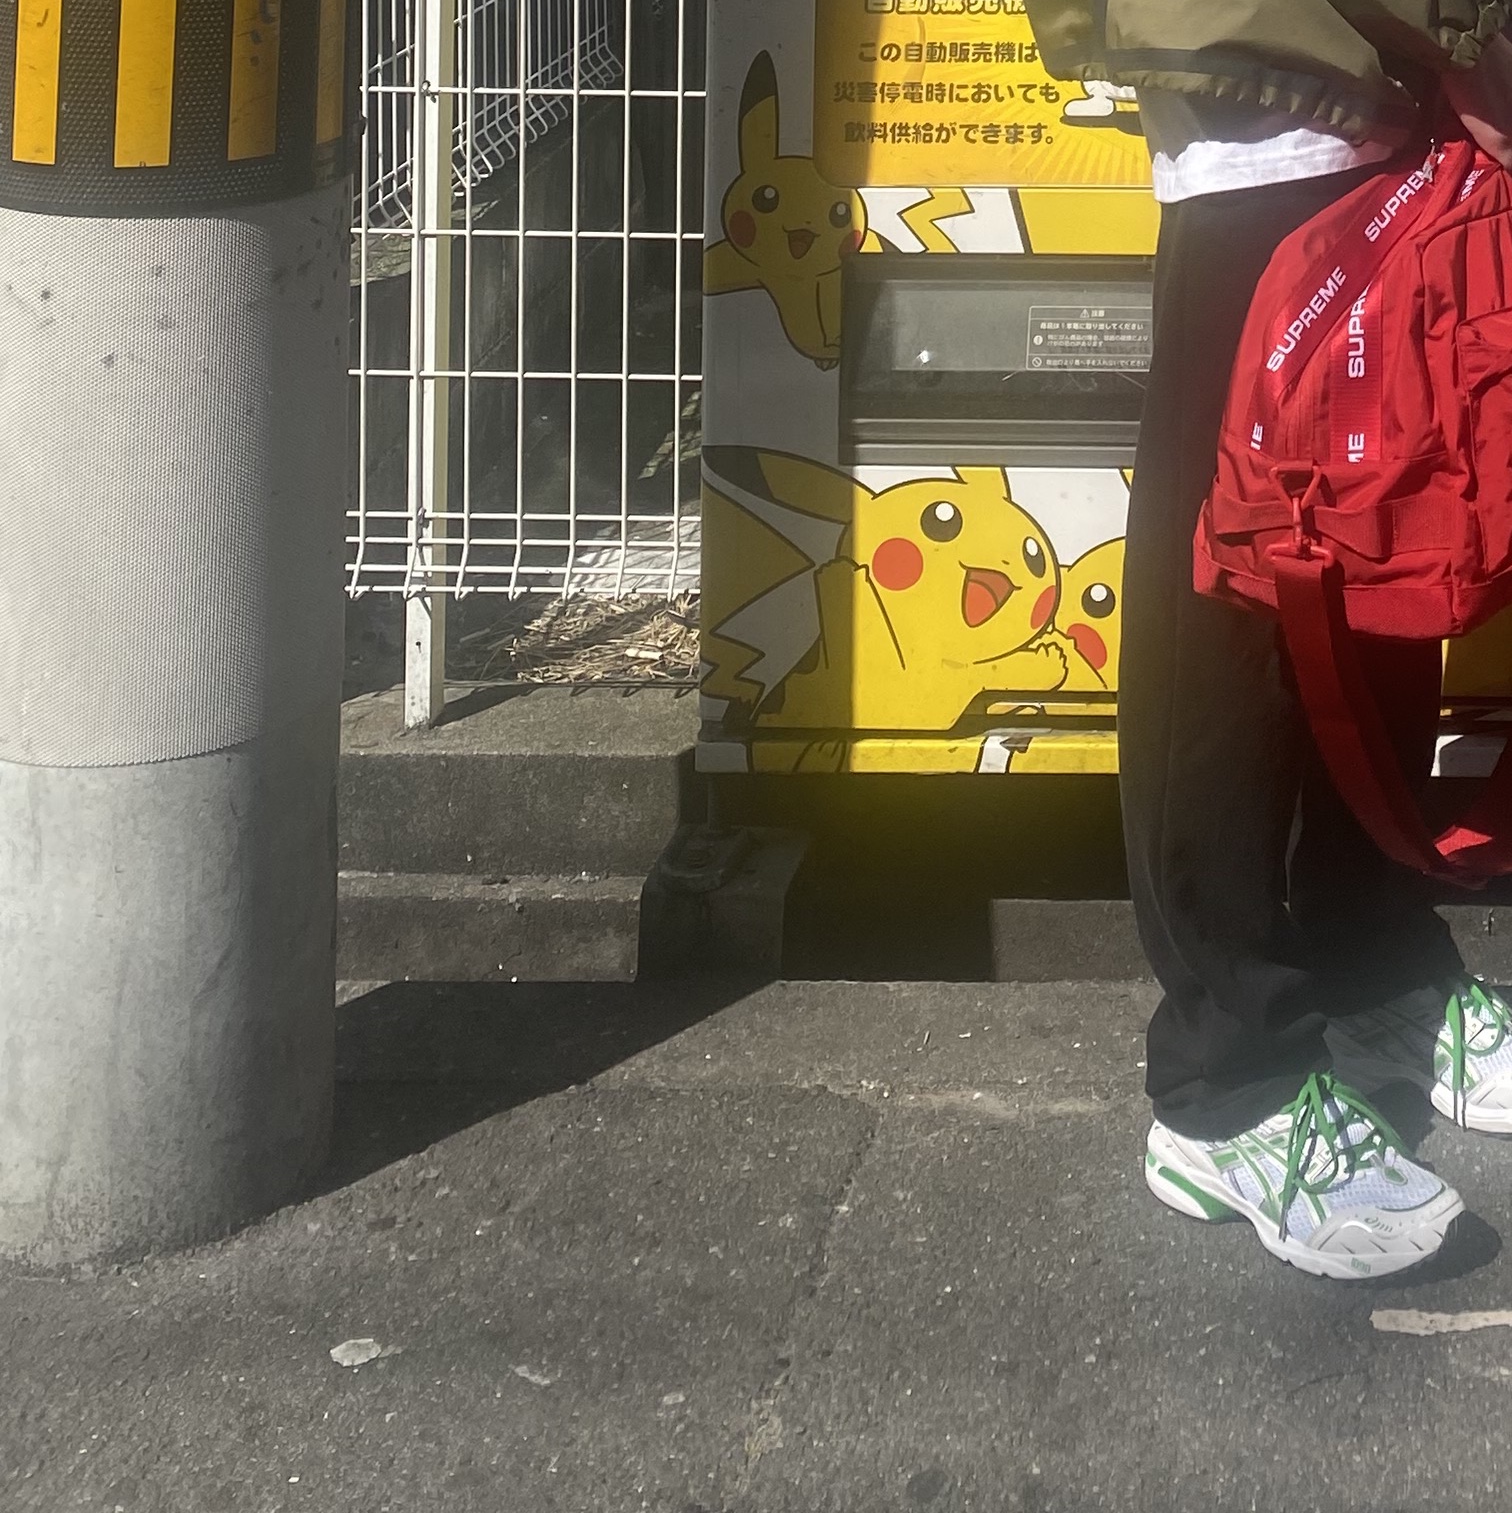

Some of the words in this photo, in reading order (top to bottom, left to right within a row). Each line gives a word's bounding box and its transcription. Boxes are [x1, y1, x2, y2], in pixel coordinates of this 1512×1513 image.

[857, 41, 1040, 63] この自動販売機は
[833, 82, 1061, 104] 災害停電時においても
[844, 122, 1055, 145] 飲料供給ができます。
[1266, 265, 1347, 372] SUPREME
